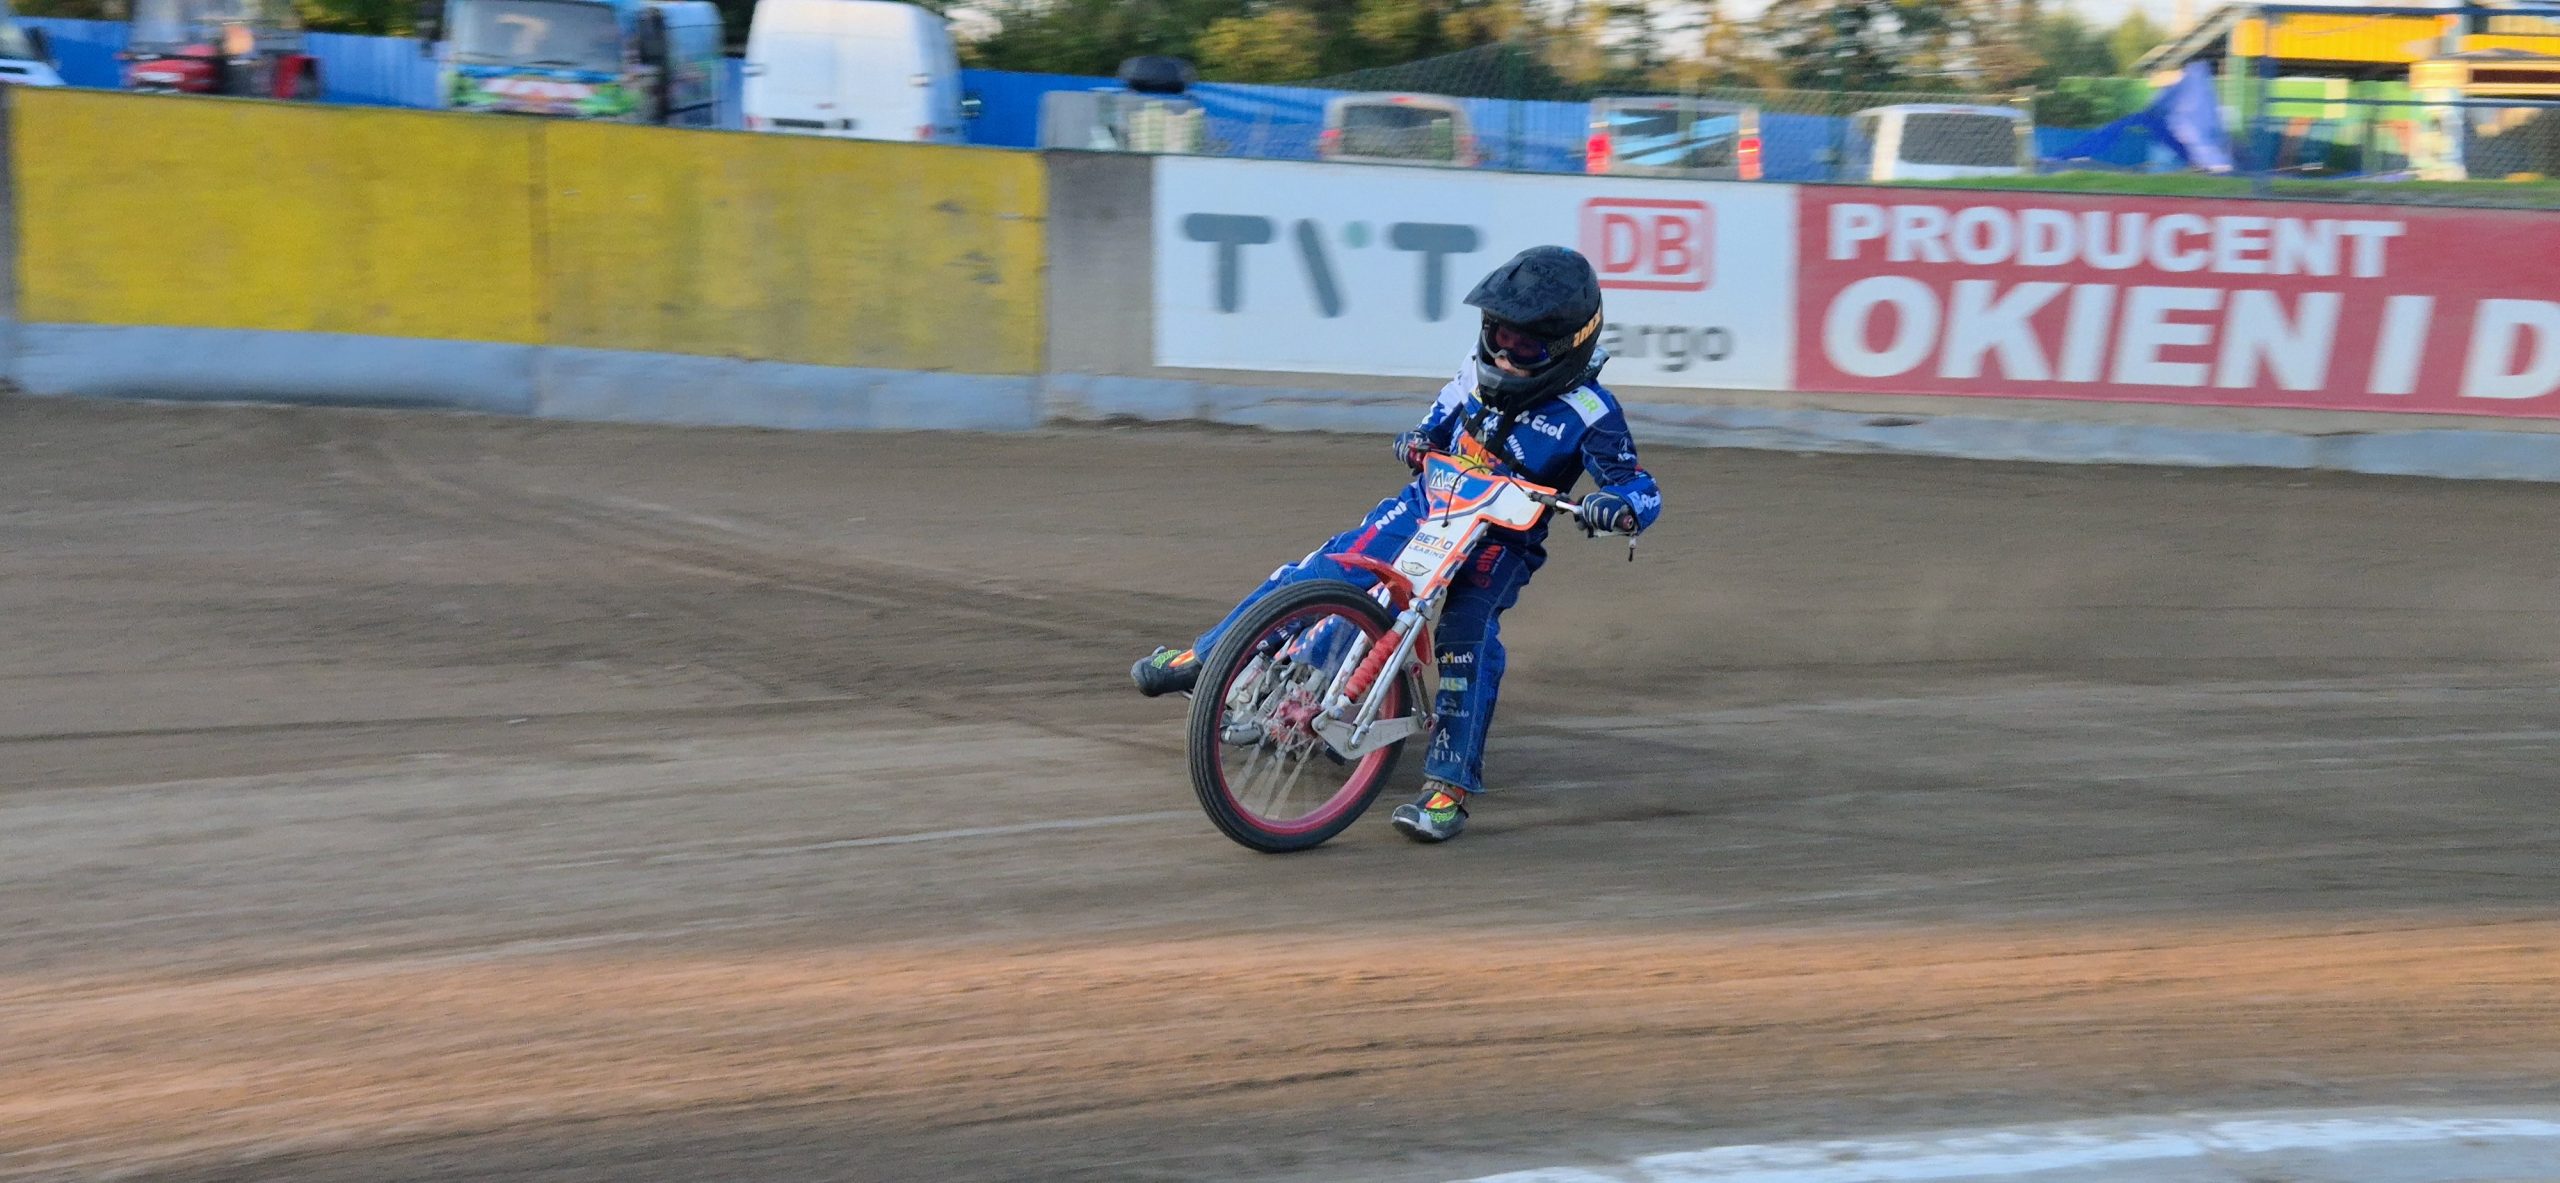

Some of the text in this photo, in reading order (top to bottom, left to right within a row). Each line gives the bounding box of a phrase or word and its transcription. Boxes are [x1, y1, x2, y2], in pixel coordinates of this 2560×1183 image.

[1601, 213, 1692, 275] DB
[1827, 203, 2407, 278] PRODUCENT
[1601, 322, 1734, 373] argo
[1821, 275, 2560, 399] OKIEN I D
[1506, 434, 1525, 460] MINI
[1531, 414, 1566, 440] Ecol
